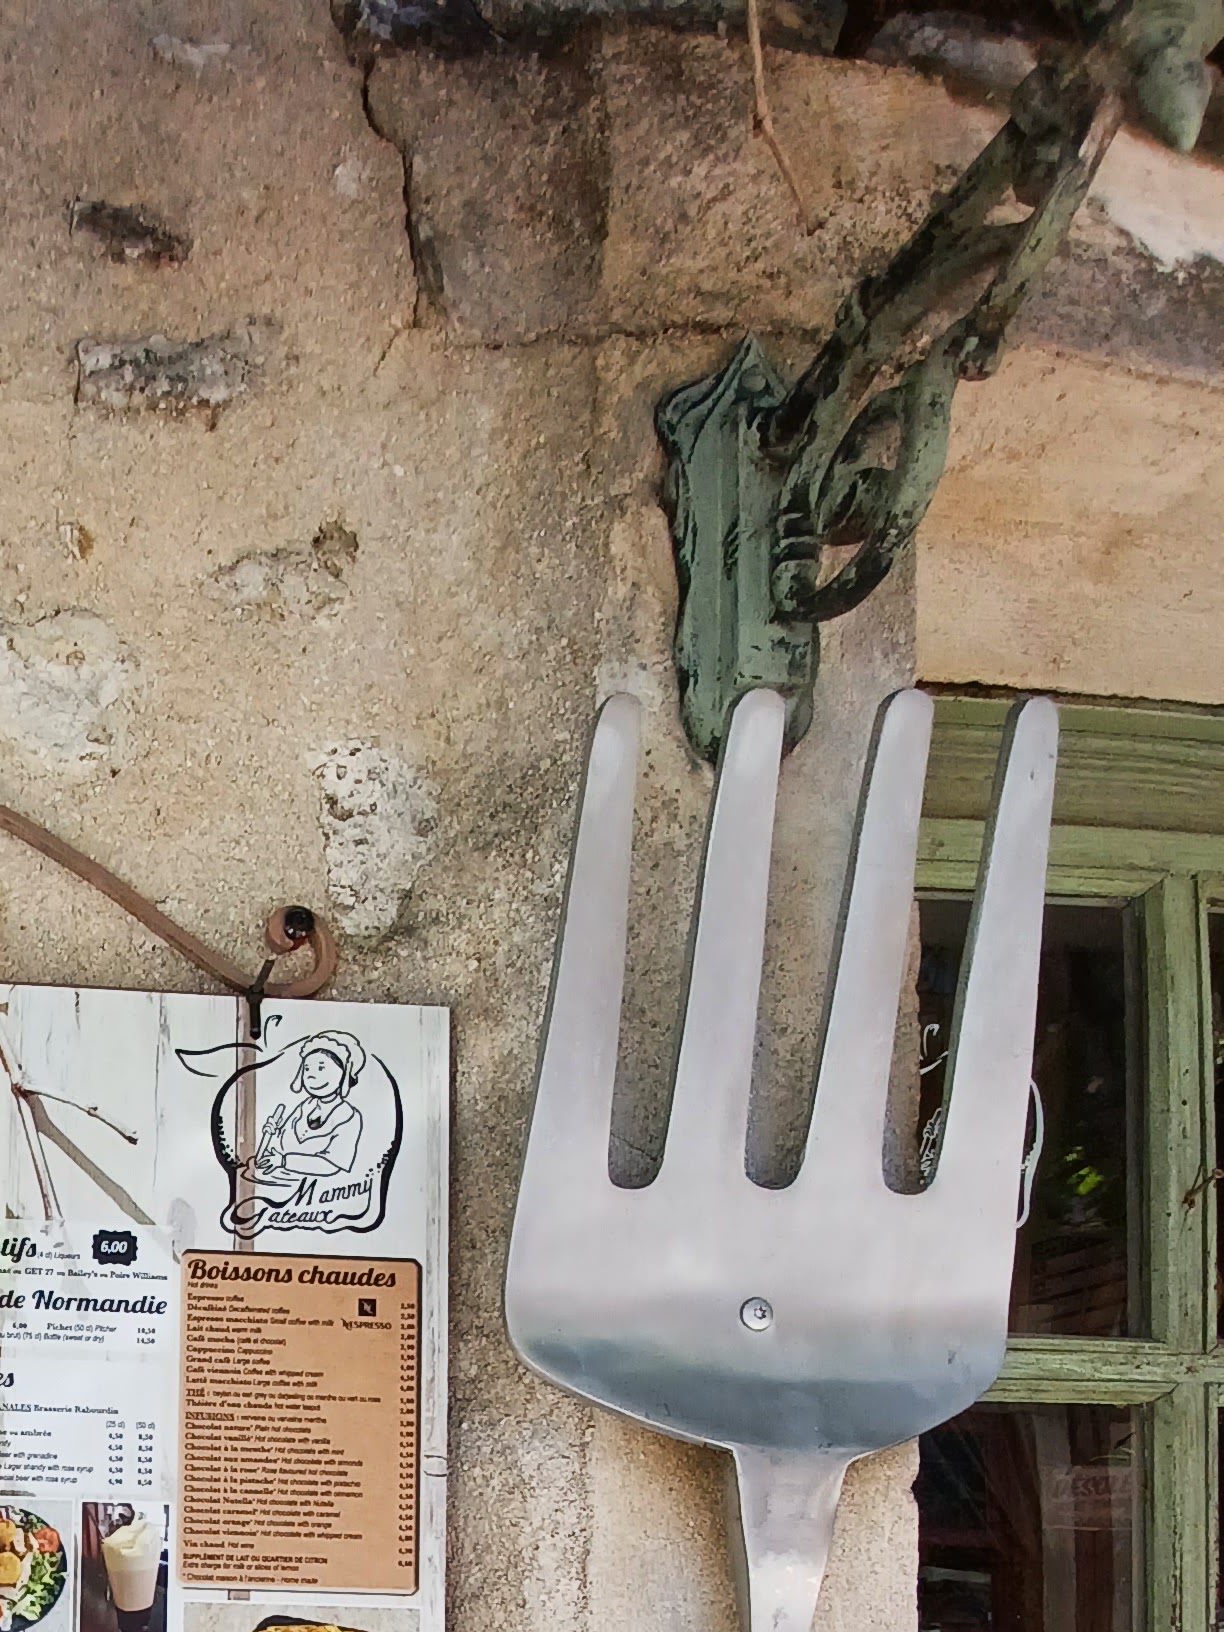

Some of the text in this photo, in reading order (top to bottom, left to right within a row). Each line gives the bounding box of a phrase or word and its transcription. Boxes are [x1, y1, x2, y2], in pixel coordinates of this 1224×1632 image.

[293, 1176, 373, 1208] Mammy
[188, 1259, 396, 1287] Boissons chaudes
[32, 1290, 167, 1315] Normandie
